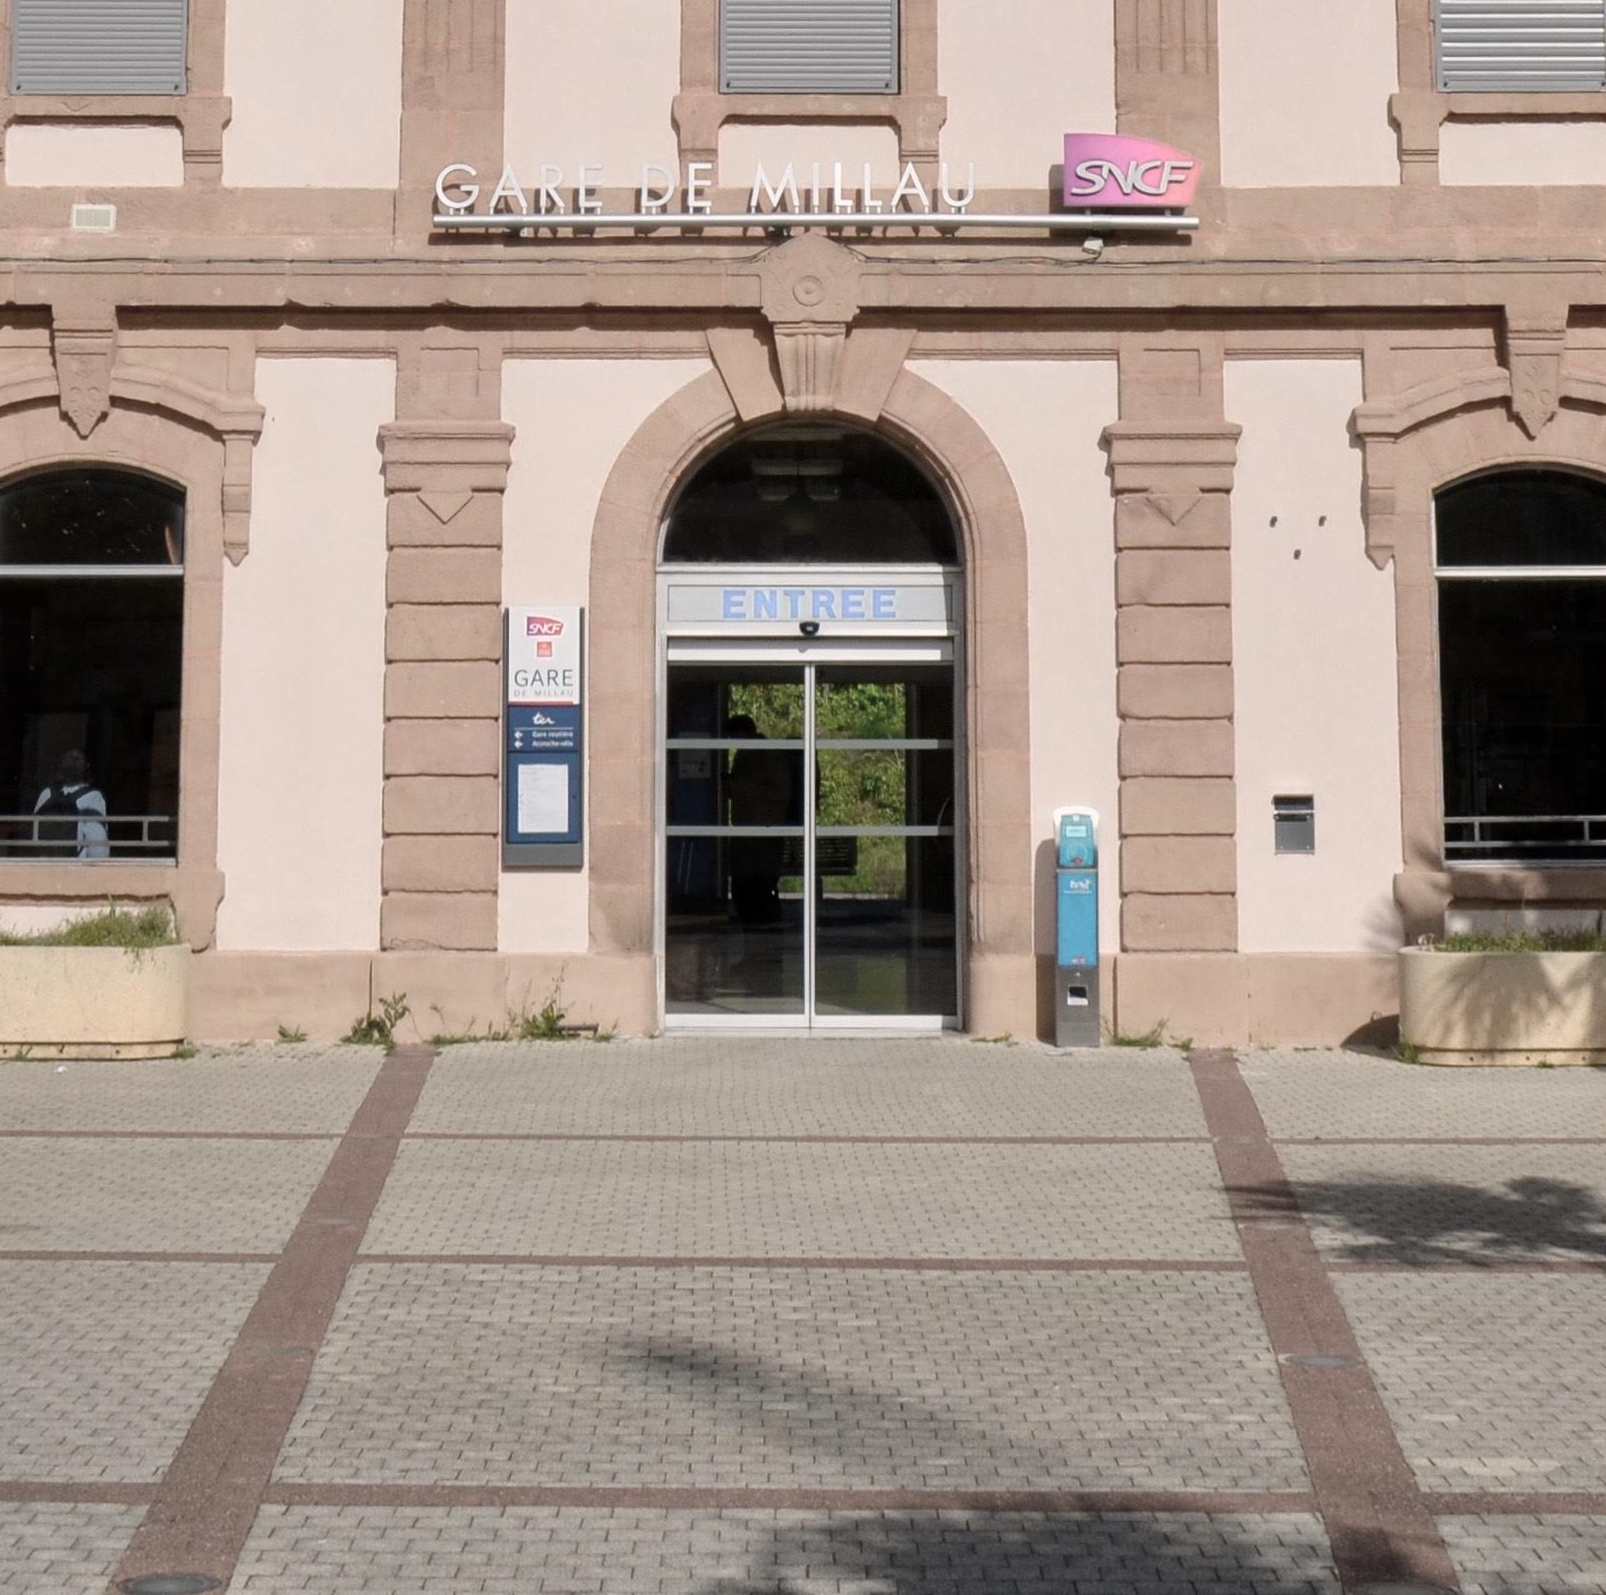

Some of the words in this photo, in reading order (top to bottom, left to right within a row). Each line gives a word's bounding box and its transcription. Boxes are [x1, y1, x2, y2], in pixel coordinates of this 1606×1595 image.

[435, 163, 603, 209] GARE
[641, 162, 712, 208] DE
[750, 160, 975, 208] MILLAU
[1071, 159, 1194, 196] SNCF
[722, 588, 897, 620] ENTREE
[527, 623, 562, 634] SNCF
[514, 669, 574, 687] GARE
[514, 689, 526, 697] DE
[534, 689, 573, 697] MILLAU
